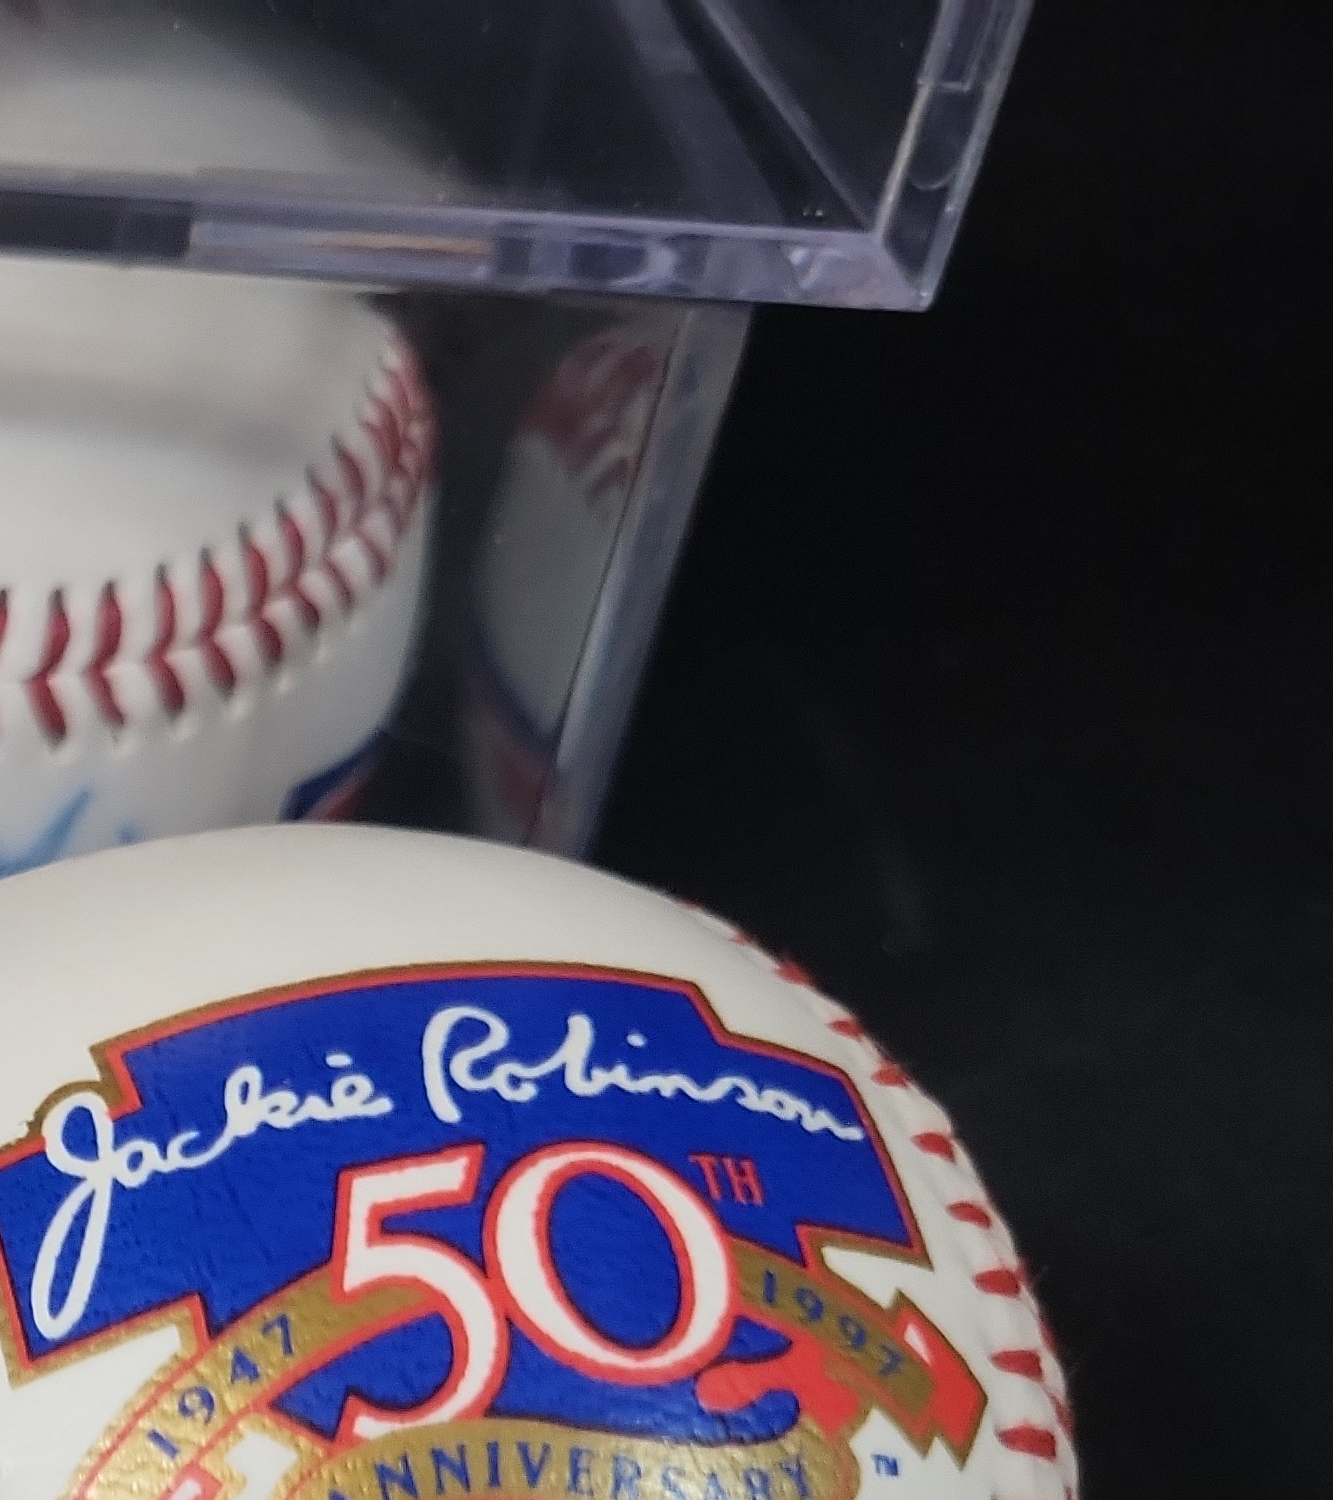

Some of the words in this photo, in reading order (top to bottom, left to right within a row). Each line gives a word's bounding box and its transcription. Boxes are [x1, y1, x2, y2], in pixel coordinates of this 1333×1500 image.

[30, 1052, 393, 1338] Jackie
[420, 1003, 866, 1143] Robinson
[143, 1314, 299, 1461] 1947
[762, 1269, 904, 1376] 1997
